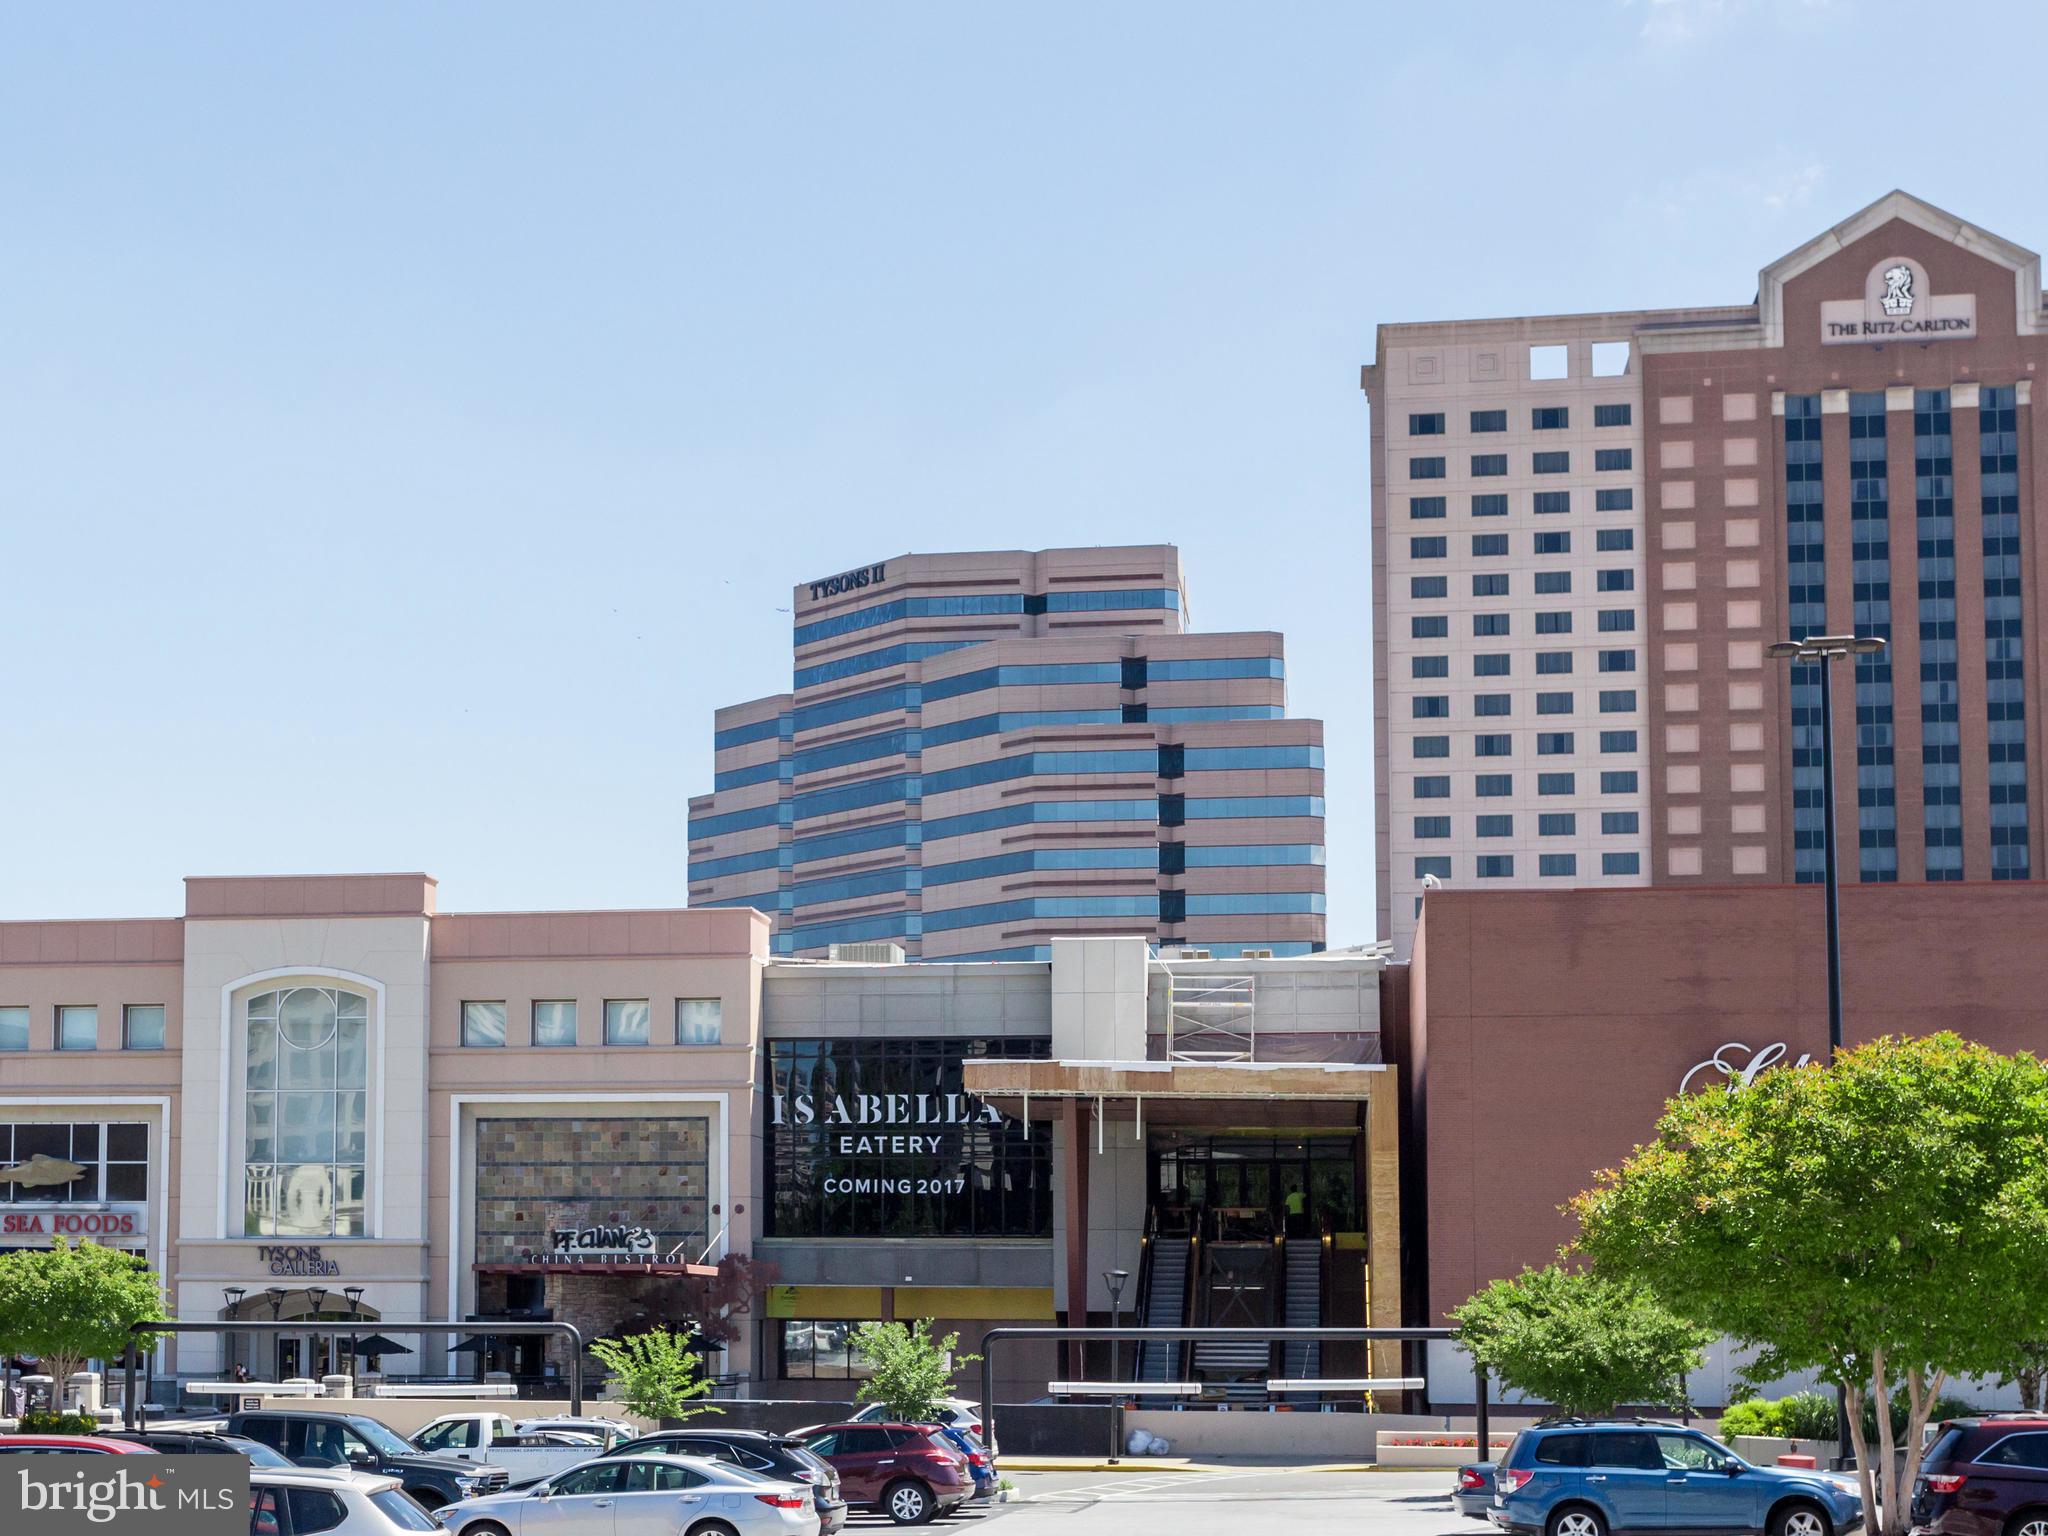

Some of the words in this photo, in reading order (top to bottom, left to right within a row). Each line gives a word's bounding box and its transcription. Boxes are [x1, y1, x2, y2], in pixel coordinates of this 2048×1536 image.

[1828, 322, 1858, 336] THE
[1862, 318, 1970, 334] RITZ-CARLTON
[810, 568, 869, 601] TYSONS
[871, 564, 885, 584] II
[771, 1093, 1003, 1125] ISABELLA
[840, 1136, 943, 1154] EATERY
[824, 1178, 912, 1195] COMING
[917, 1179, 966, 1195] 2017
[3, 1214, 44, 1234] SEA
[53, 1214, 134, 1233] FOODS
[258, 1246, 322, 1262] TYSONS
[531, 1254, 584, 1264] CHINA
[601, 1254, 676, 1264] BISTRO
[269, 1260, 340, 1277] GALLERIA
